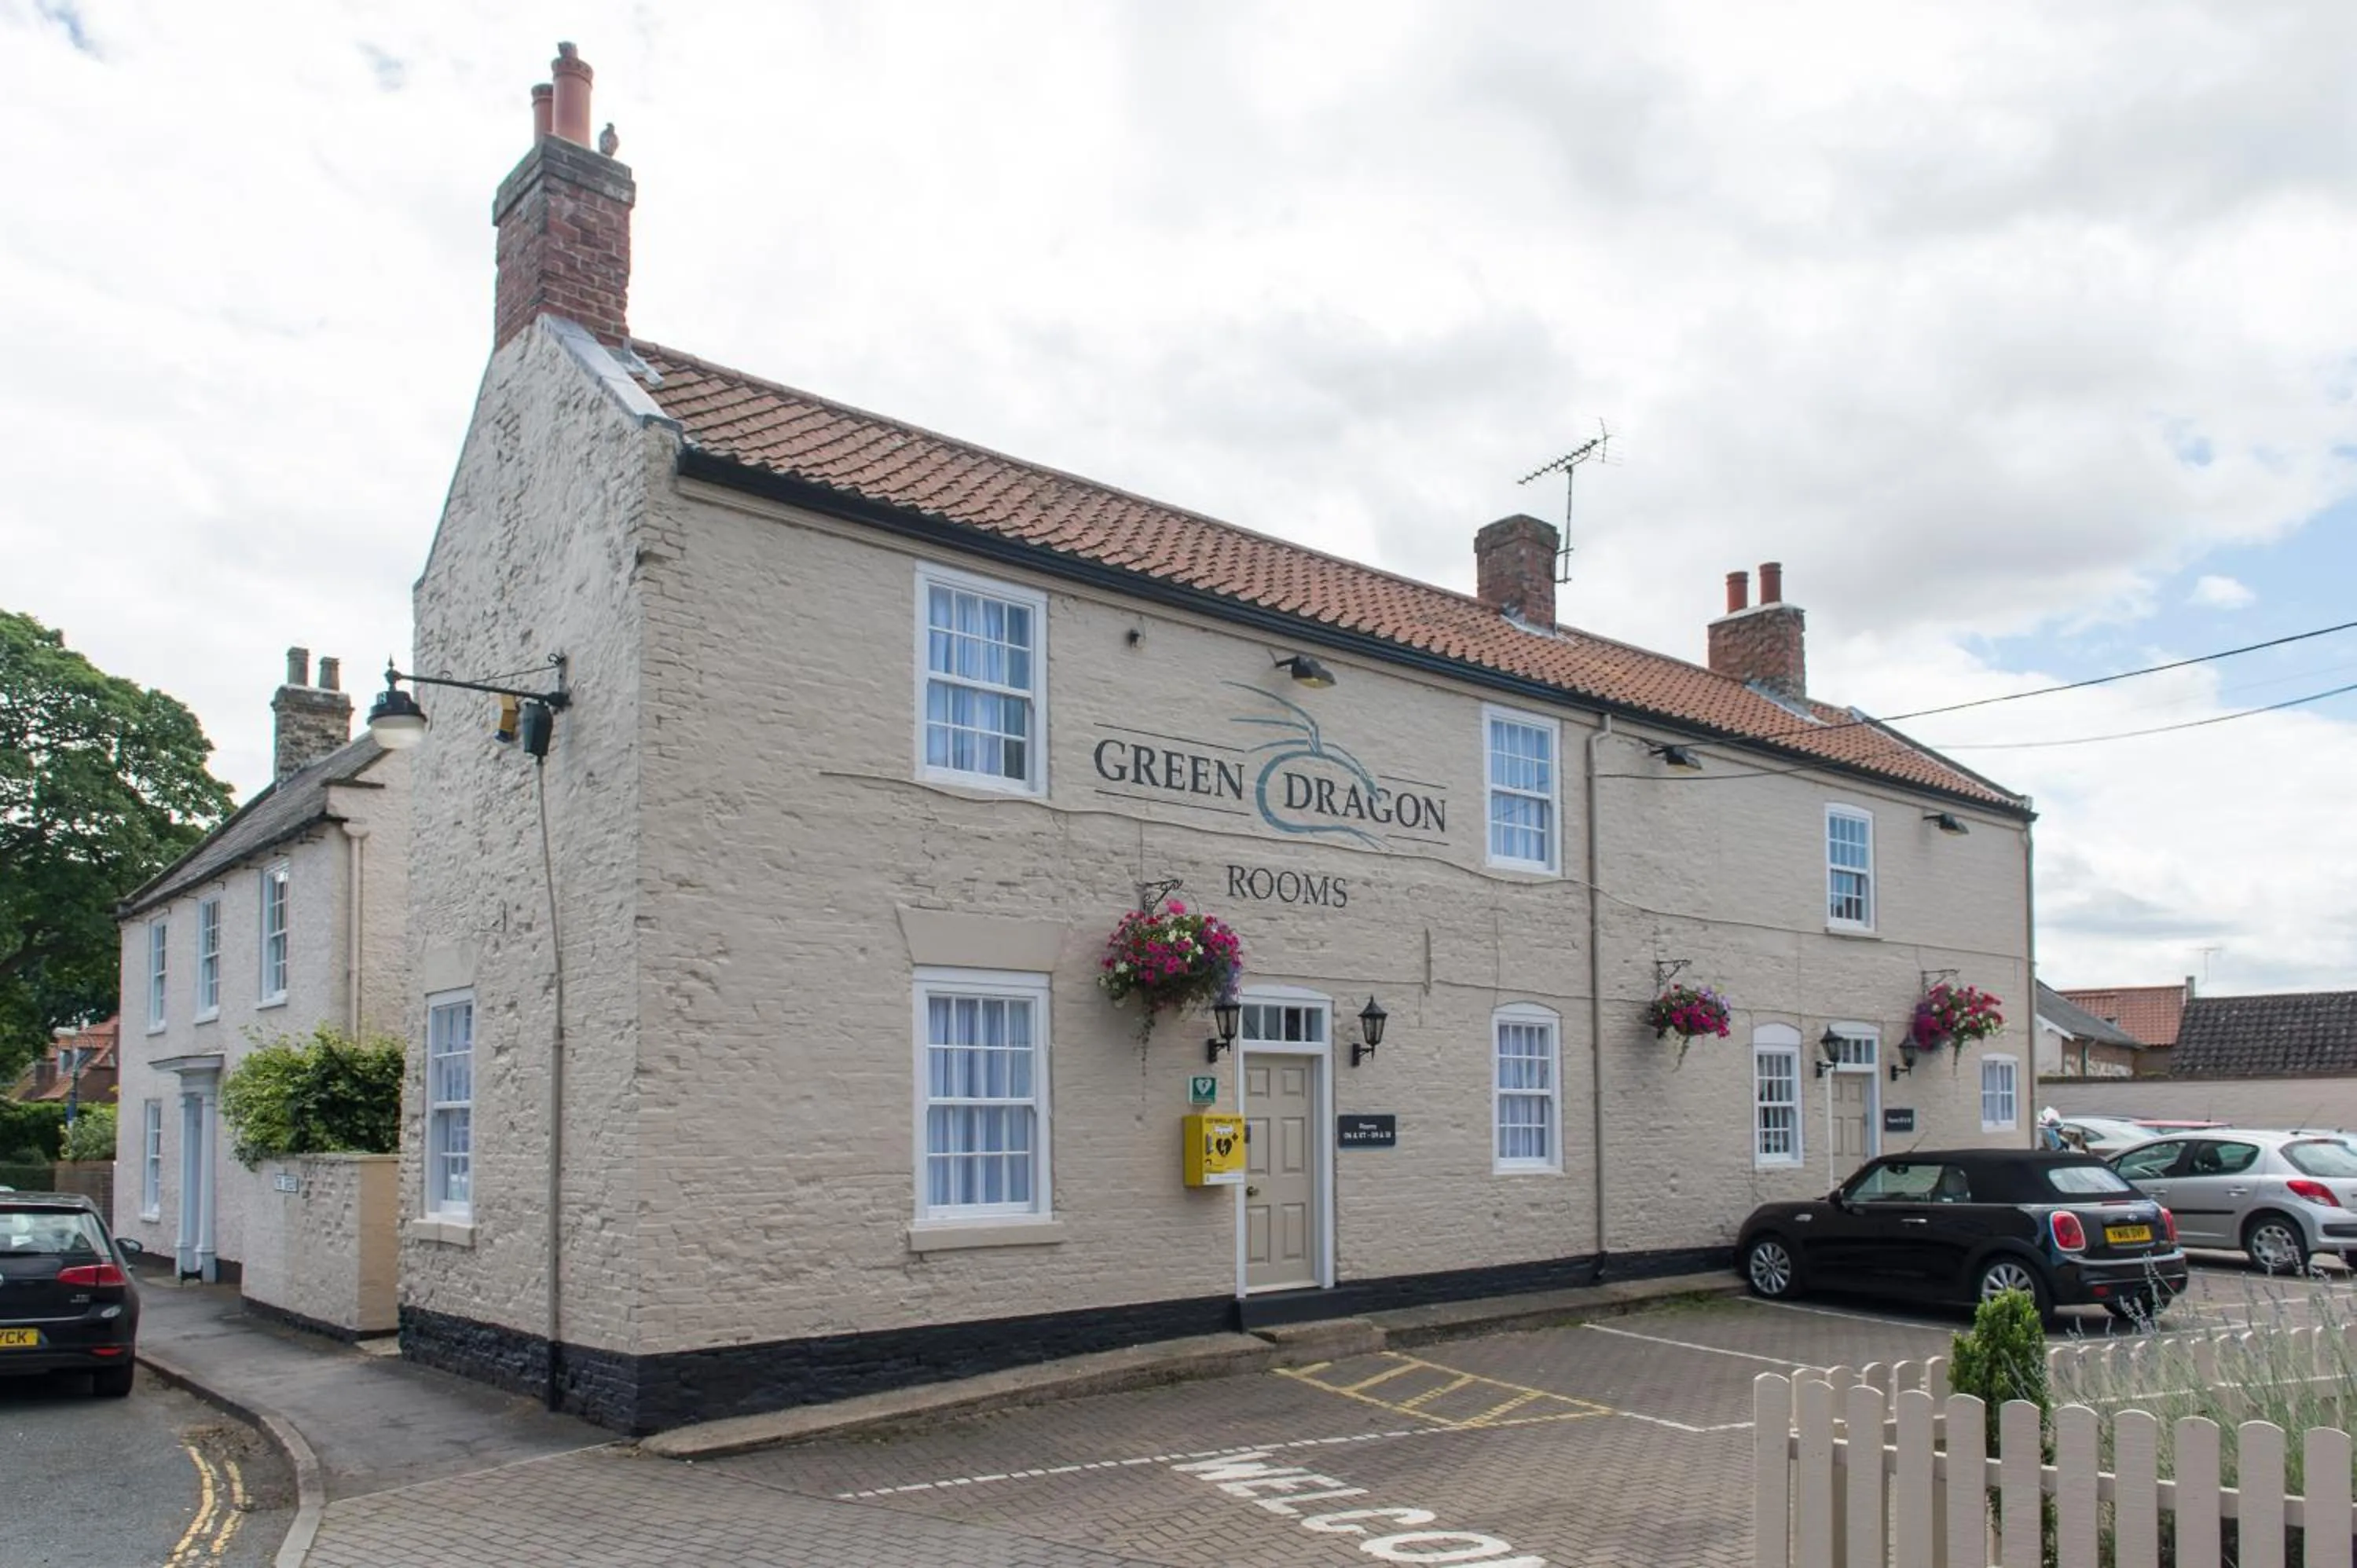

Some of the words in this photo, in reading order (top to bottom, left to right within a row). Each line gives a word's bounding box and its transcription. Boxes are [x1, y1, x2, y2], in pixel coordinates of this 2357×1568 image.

[1094, 738, 1244, 800] GREEN
[1285, 771, 1446, 833] DRAGON
[1227, 865, 1347, 908] ROOMS
[1171, 1451, 1546, 1568] WELCO
